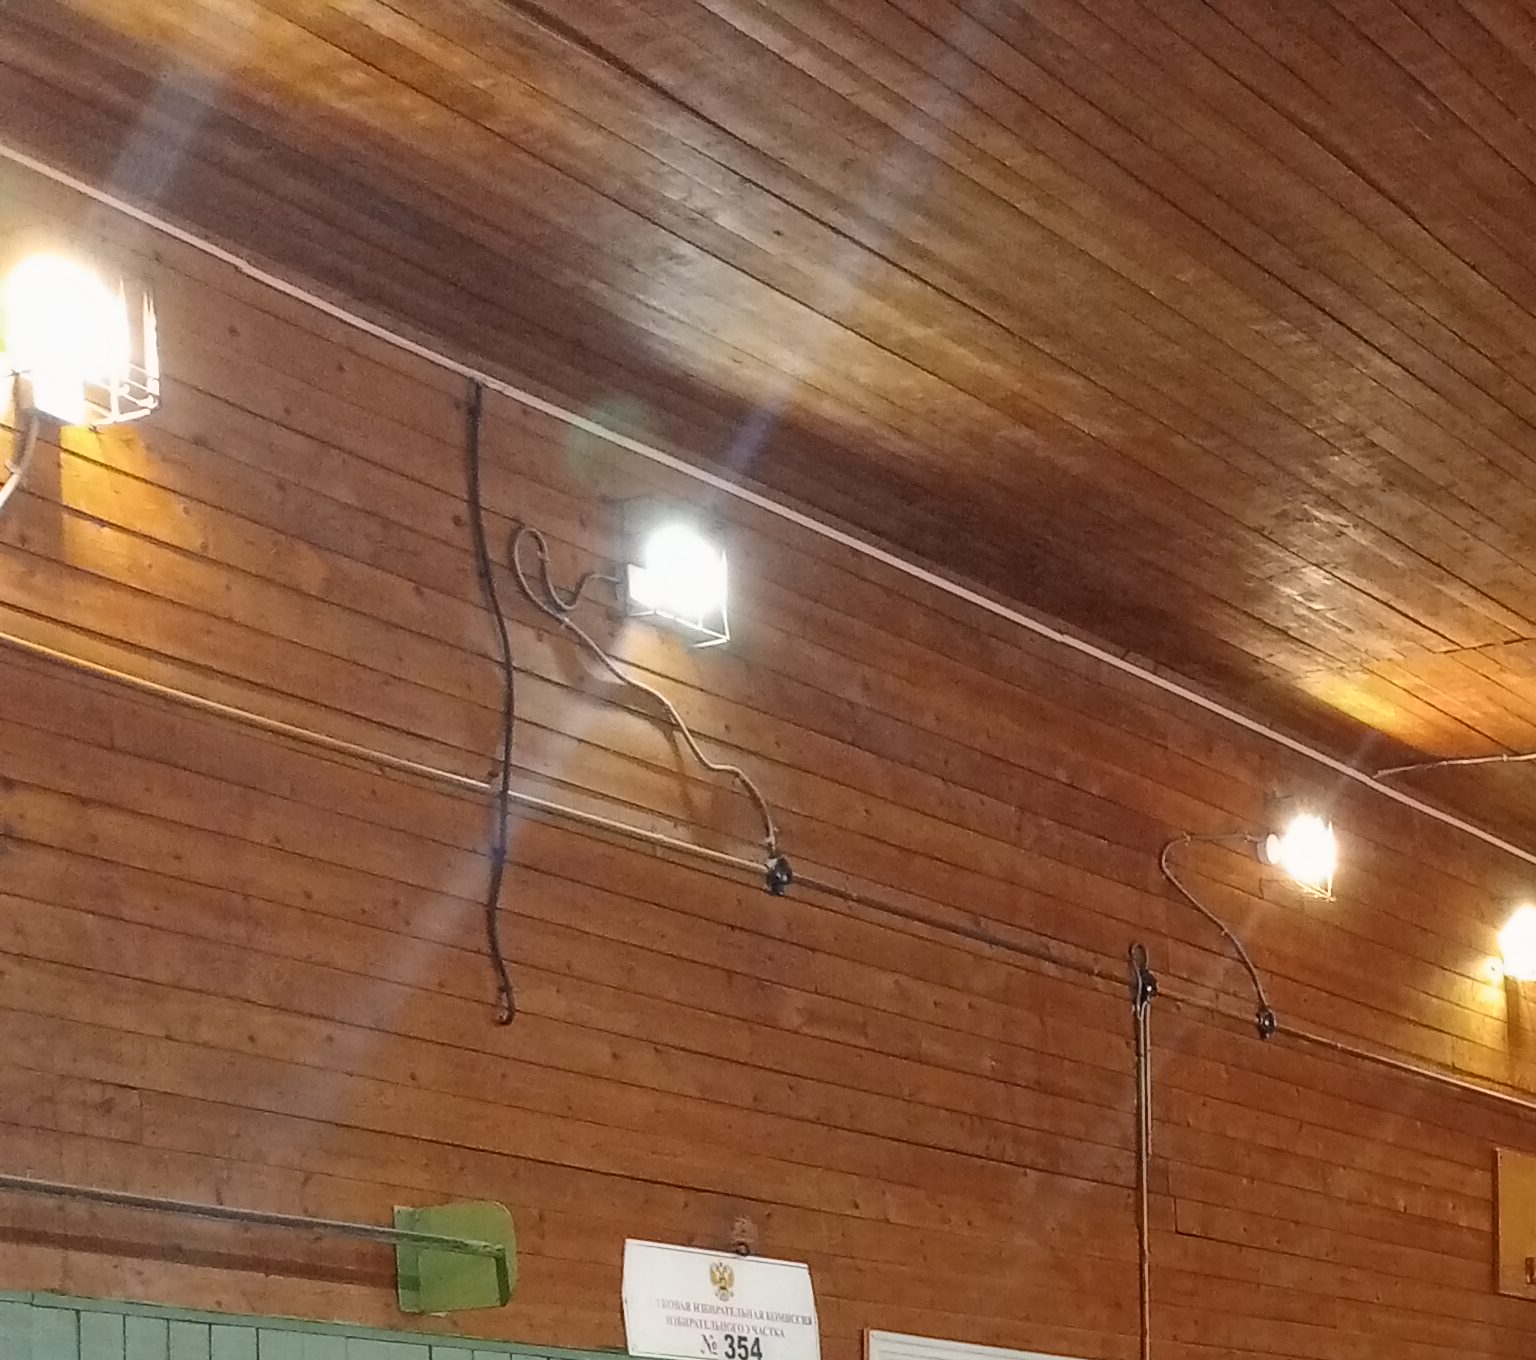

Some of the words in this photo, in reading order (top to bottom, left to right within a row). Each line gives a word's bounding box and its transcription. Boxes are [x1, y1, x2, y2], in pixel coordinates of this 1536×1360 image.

[766, 1310, 813, 1326] КОМИССИЯ
[745, 1323, 785, 1338] УЧАСТКА
[700, 1334, 718, 1356] №
